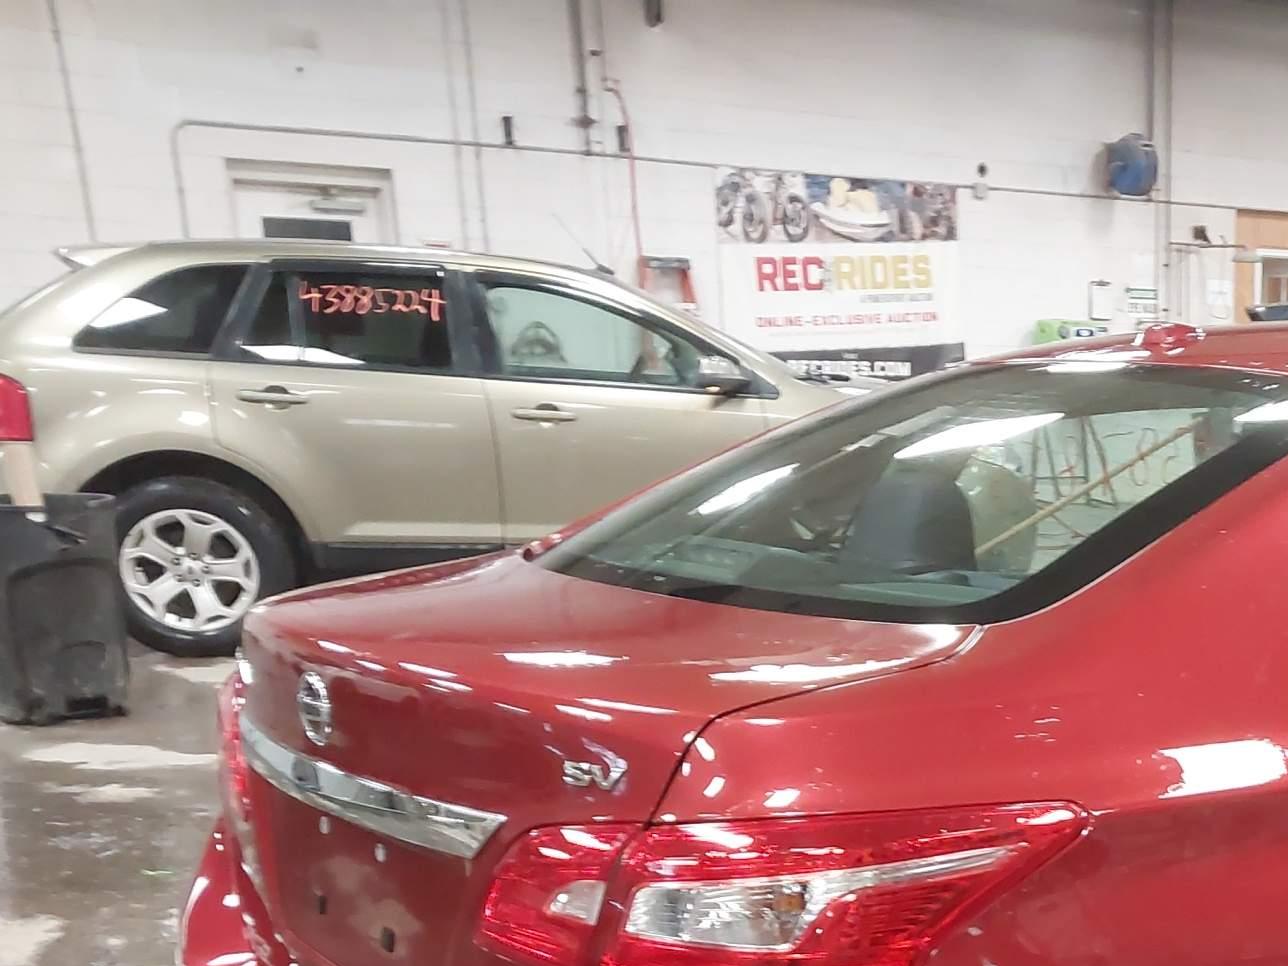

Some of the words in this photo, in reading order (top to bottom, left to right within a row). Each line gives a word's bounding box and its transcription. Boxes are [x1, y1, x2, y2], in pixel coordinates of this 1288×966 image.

[756, 256, 826, 292] REC
[835, 254, 933, 290] RIDES
[299, 281, 448, 321] 43885224
[888, 311, 939, 323] AUCTION
[562, 758, 628, 791] SV
